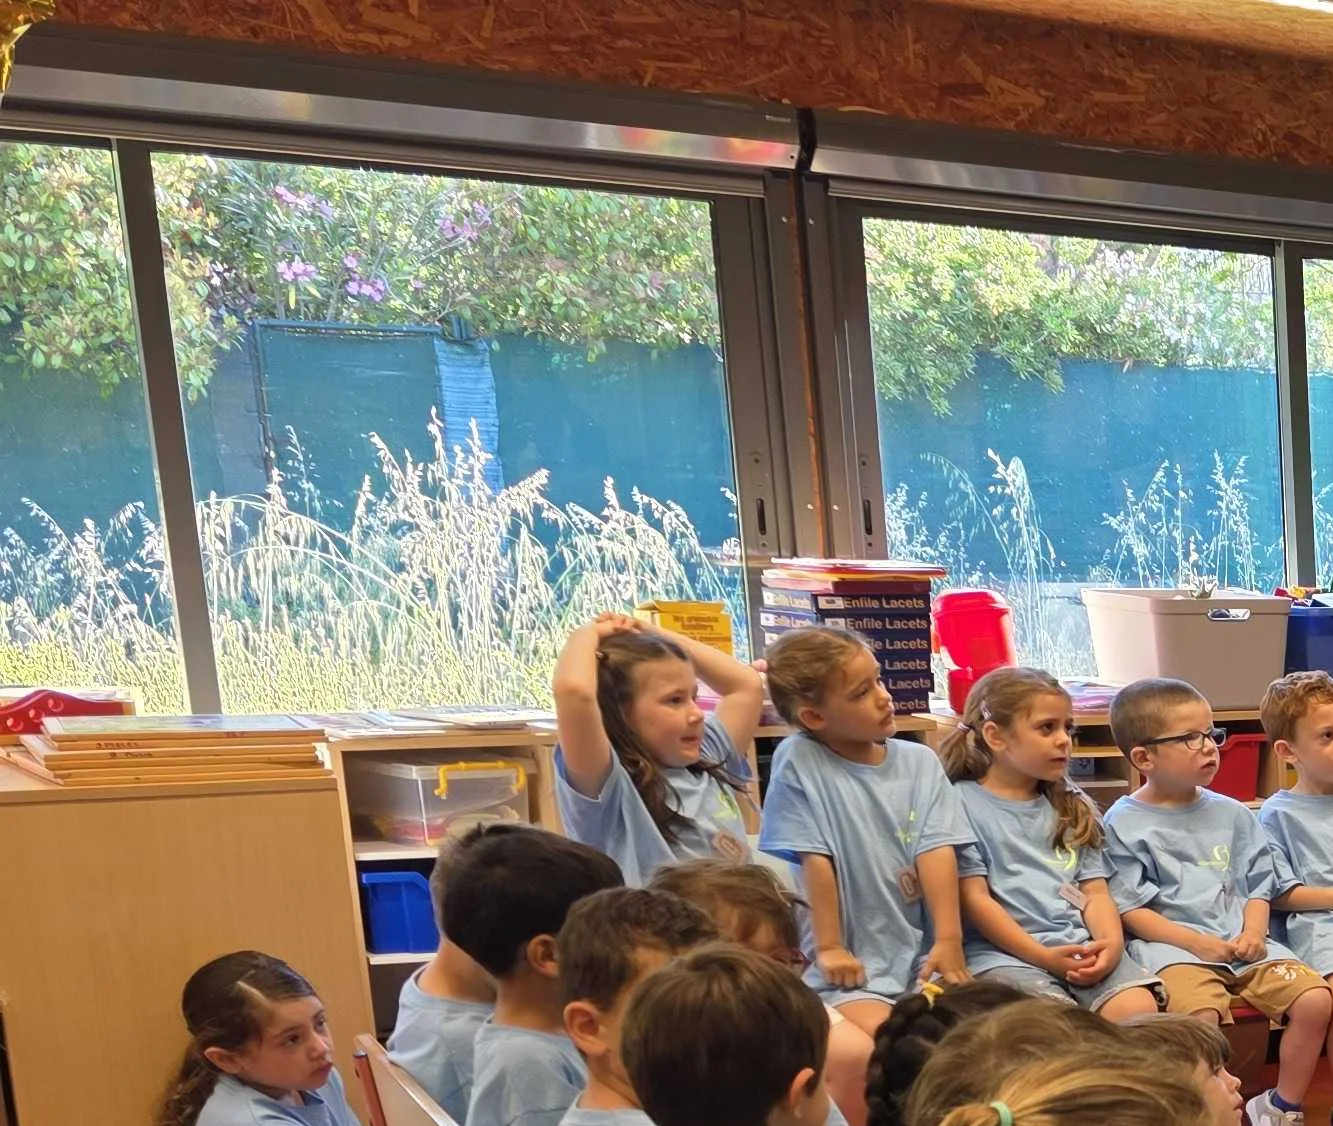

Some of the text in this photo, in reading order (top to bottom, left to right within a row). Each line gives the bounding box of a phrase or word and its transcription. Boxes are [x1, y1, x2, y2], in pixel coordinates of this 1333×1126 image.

[843, 597, 925, 609] Enfile Lacets
[845, 617, 928, 630] Enfile Lacets
[885, 637, 928, 650] Lacets
[885, 658, 928, 670] Lacets
[889, 677, 931, 690] Lacets
[893, 699, 928, 710] acets
